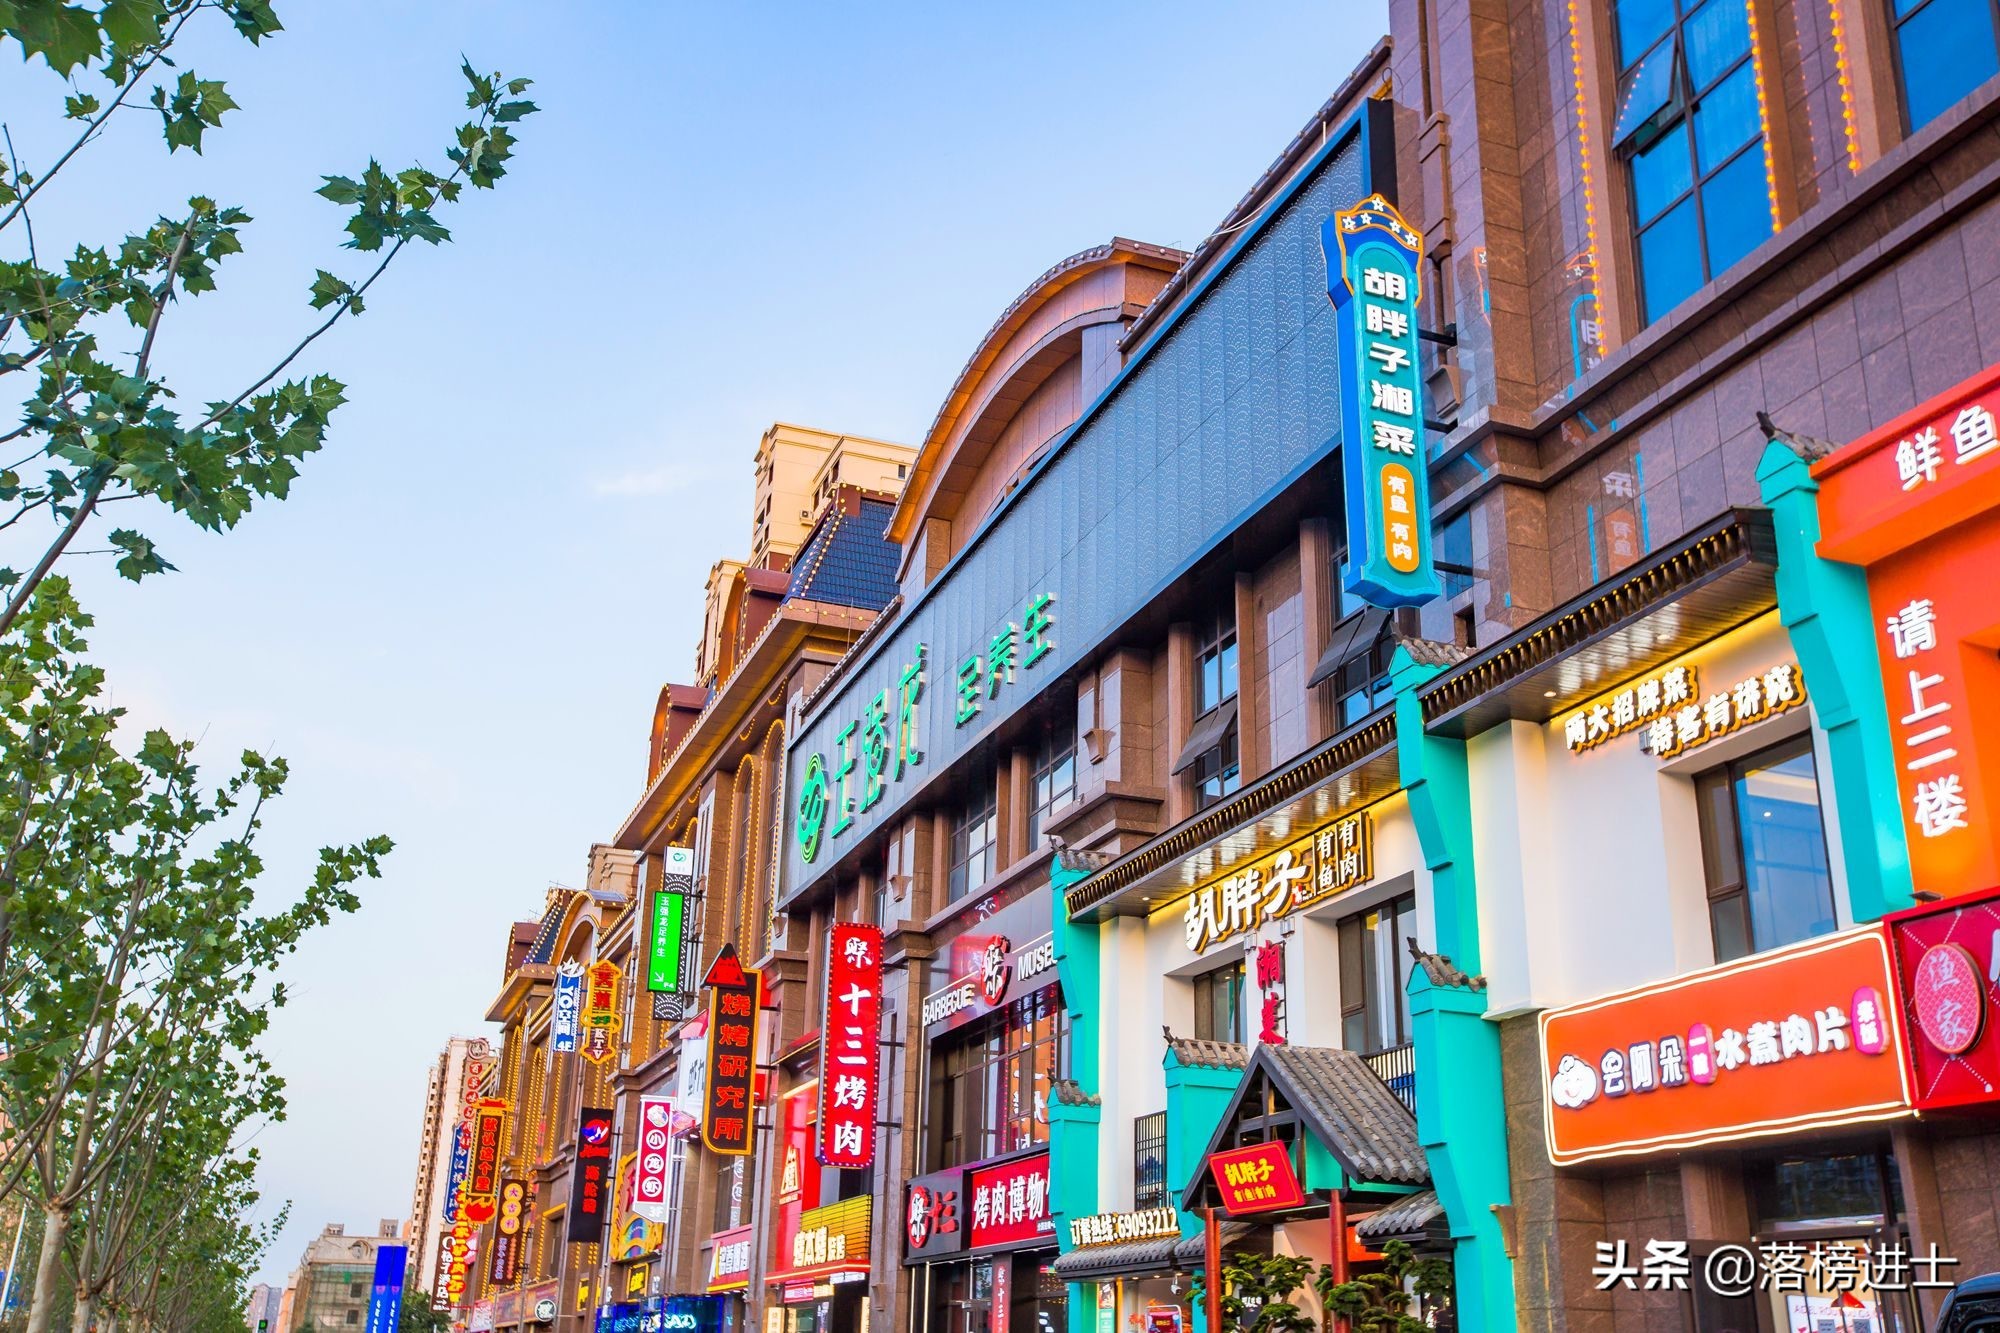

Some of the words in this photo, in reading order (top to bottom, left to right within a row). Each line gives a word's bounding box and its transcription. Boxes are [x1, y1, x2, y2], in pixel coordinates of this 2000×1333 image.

[1364, 267, 1415, 455] 胡胖子湘菜
[1564, 667, 1688, 749] 两大招牌菜
[1650, 665, 1795, 755] 待客有讲究
[1887, 599, 1968, 838] 请上二楼
[1316, 832, 1336, 894] 有鱼
[1339, 820, 1358, 881] 有肉
[1184, 850, 1306, 951] 胡胖子
[922, 984, 975, 1027] BARBECUE
[556, 1040, 573, 1051] 4F
[594, 1027, 605, 1059] KTV
[713, 994, 750, 1142] 烧烤研究所
[1715, 1007, 1847, 1070] 水煮肉片
[644, 1131, 665, 1196] 小龙虾
[503, 1185, 521, 1232] 大吉利
